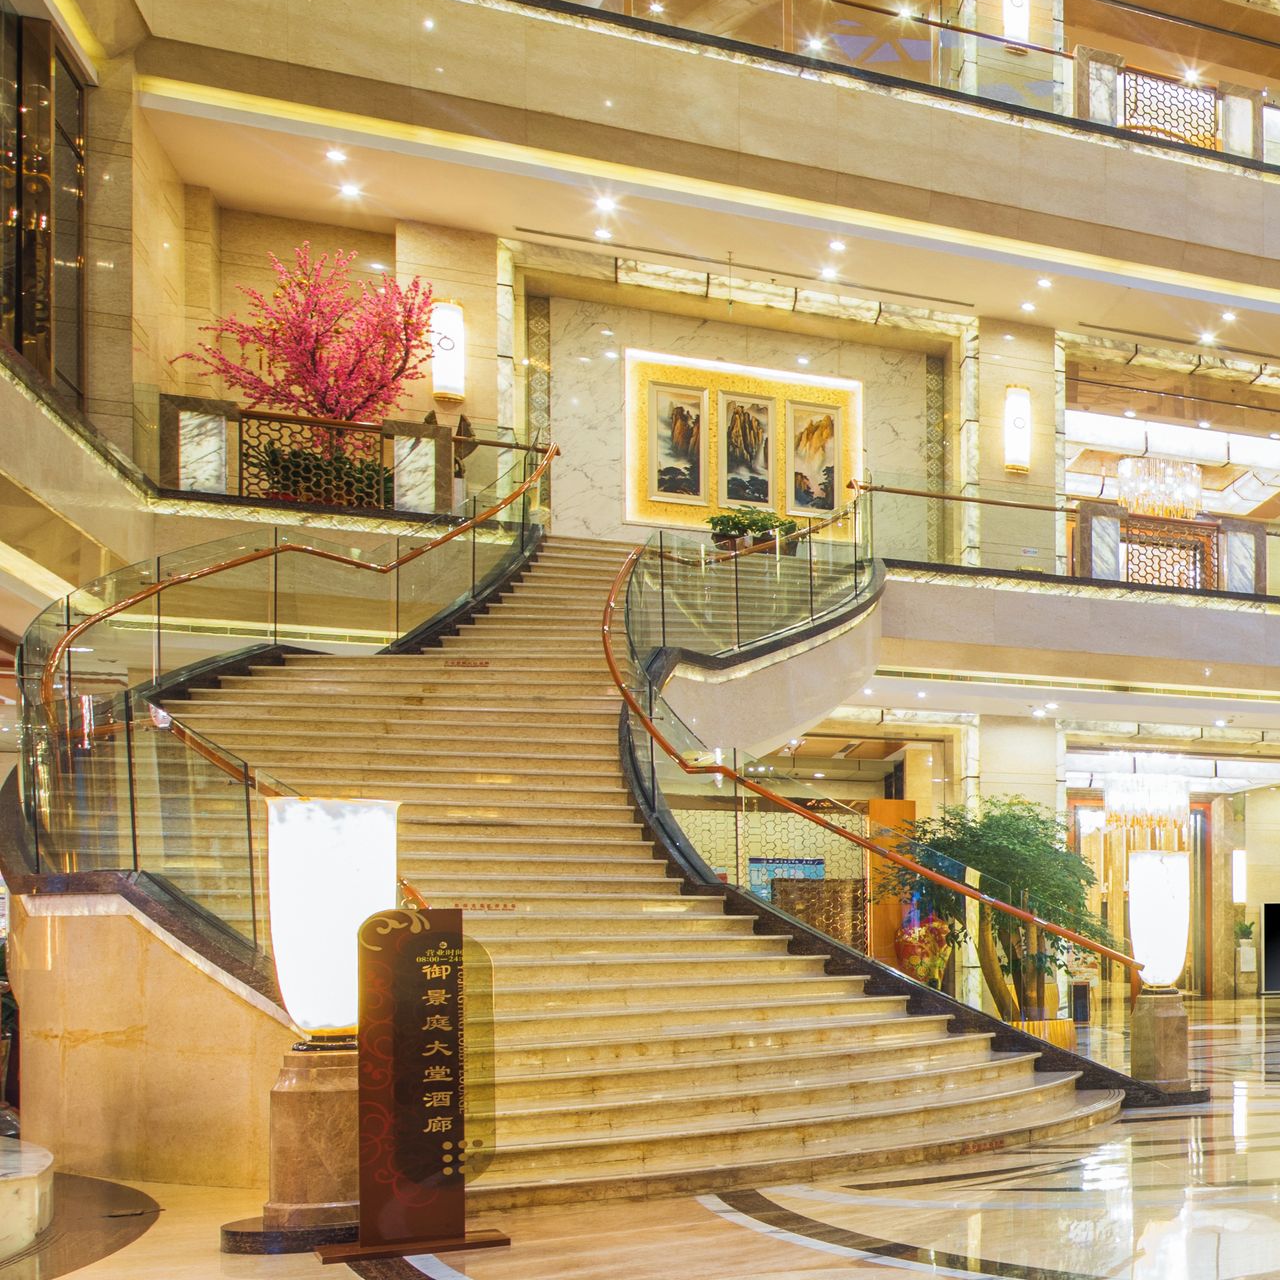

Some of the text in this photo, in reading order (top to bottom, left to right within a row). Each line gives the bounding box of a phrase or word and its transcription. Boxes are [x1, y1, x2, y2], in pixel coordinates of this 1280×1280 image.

[421, 964, 454, 1133] 御景庭大堂酒廊
